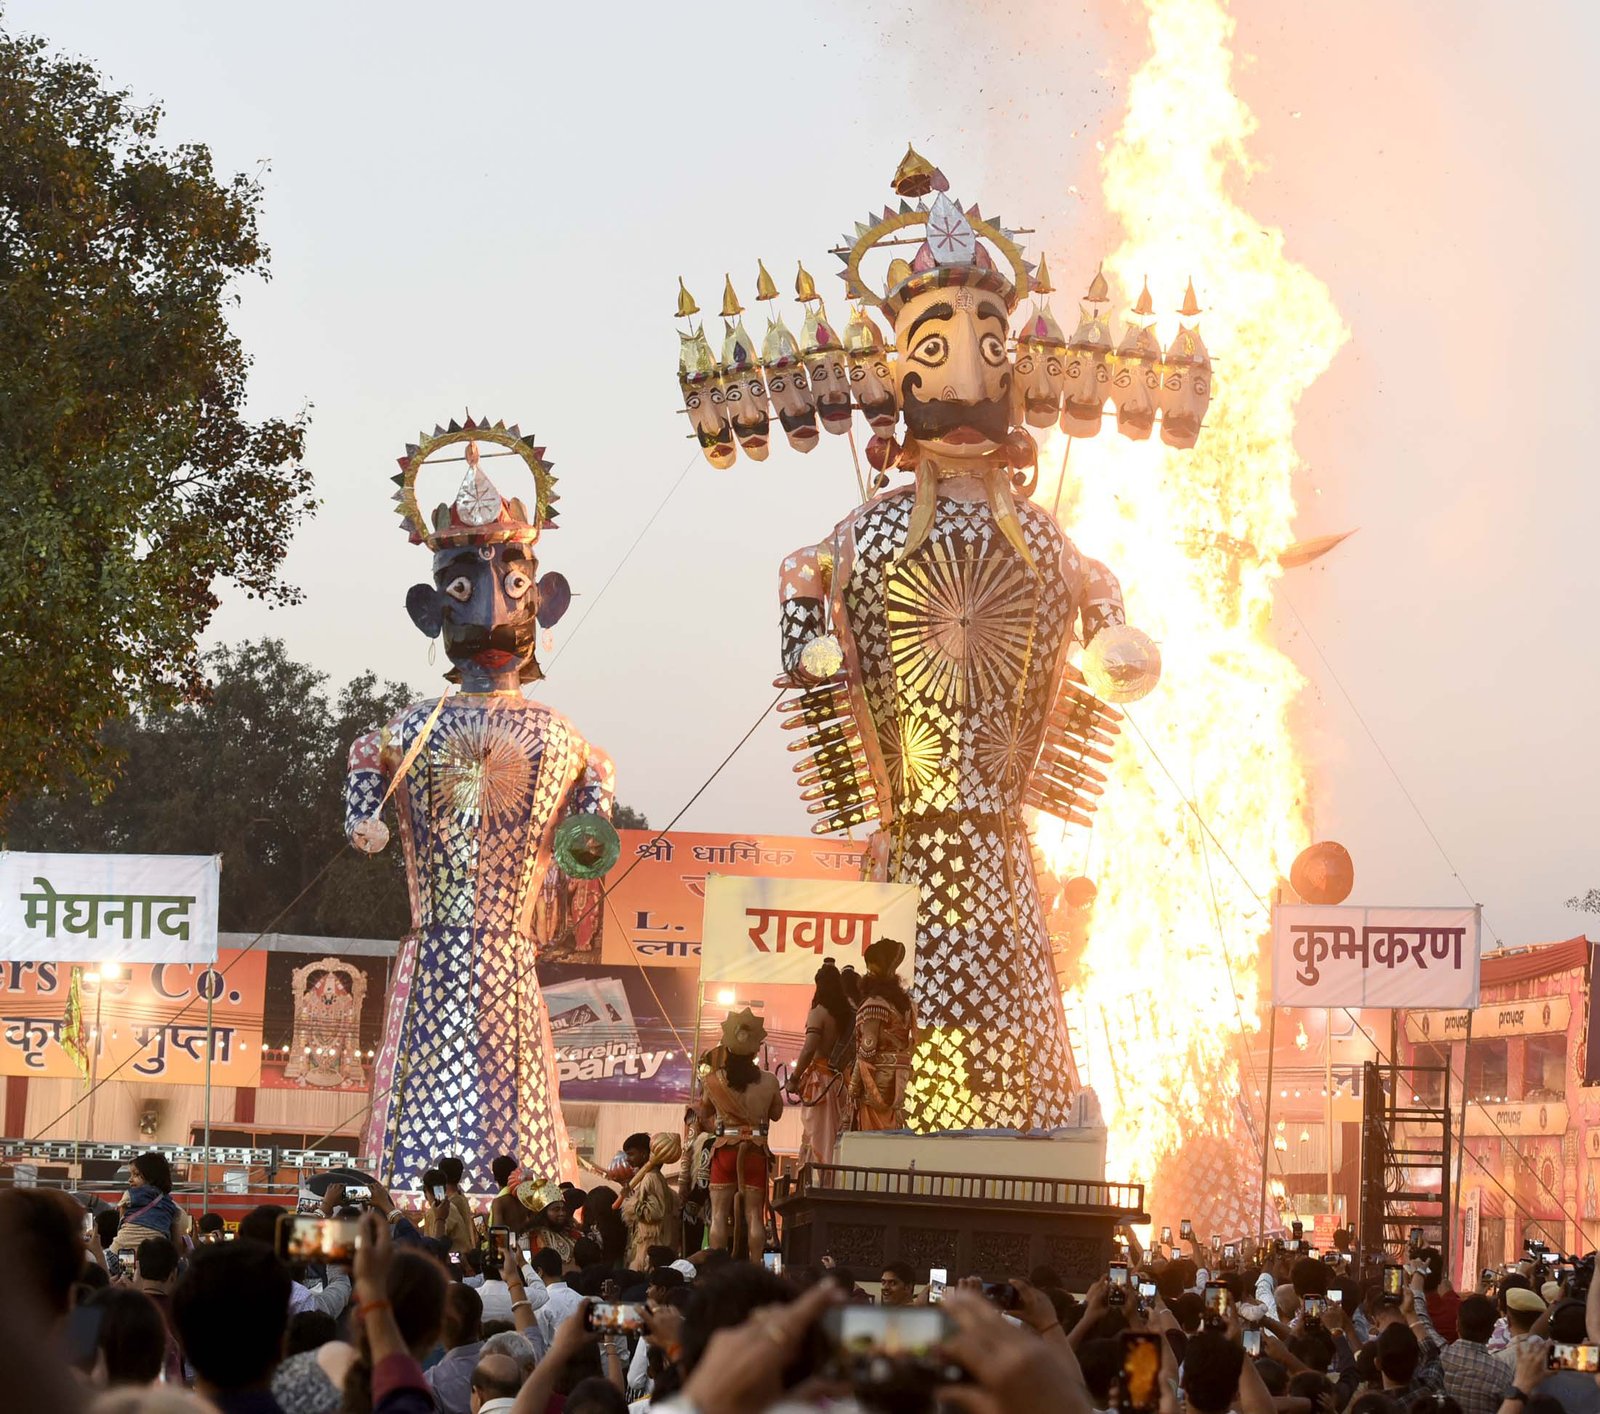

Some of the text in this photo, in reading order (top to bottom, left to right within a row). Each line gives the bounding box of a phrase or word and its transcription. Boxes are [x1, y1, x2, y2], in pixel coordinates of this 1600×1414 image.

[635, 838, 673, 861] श्री
[692, 841, 794, 865] धार्मिक
[20, 876, 197, 941] मेघनाद
[745, 907, 879, 957] रावण
[0, 961, 58, 993] rs
[151, 962, 241, 1001] Co.
[1290, 925, 1467, 987] कुम्भकरण
[131, 1023, 235, 1075] गुप्ता
